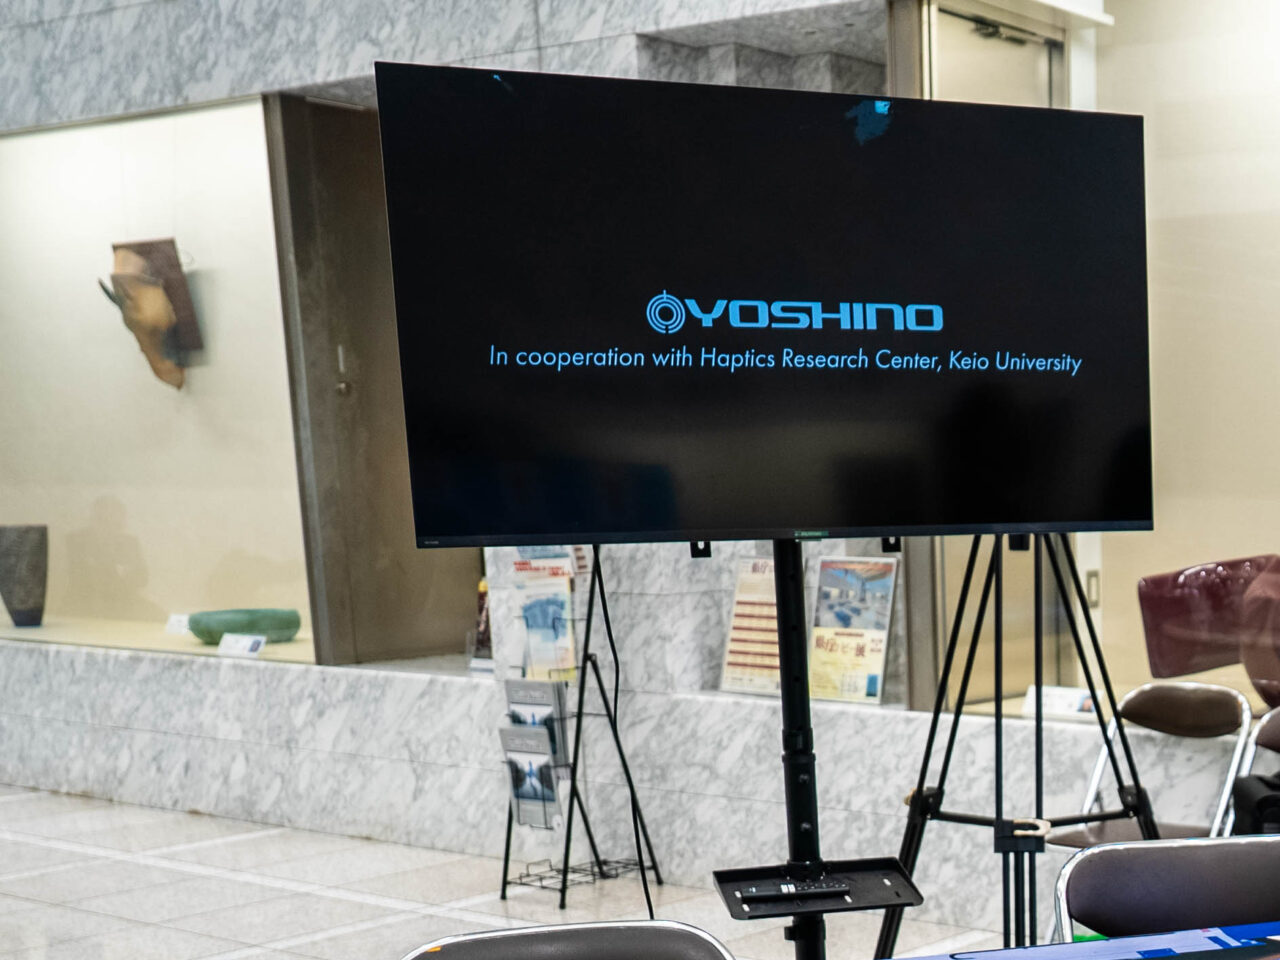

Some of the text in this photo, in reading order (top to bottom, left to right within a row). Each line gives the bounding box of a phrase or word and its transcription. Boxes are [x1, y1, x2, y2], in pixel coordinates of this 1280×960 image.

[684, 298, 944, 331] YOSHINO
[489, 344, 1083, 377] In cooperation with Haptics Research Center, Keio University
